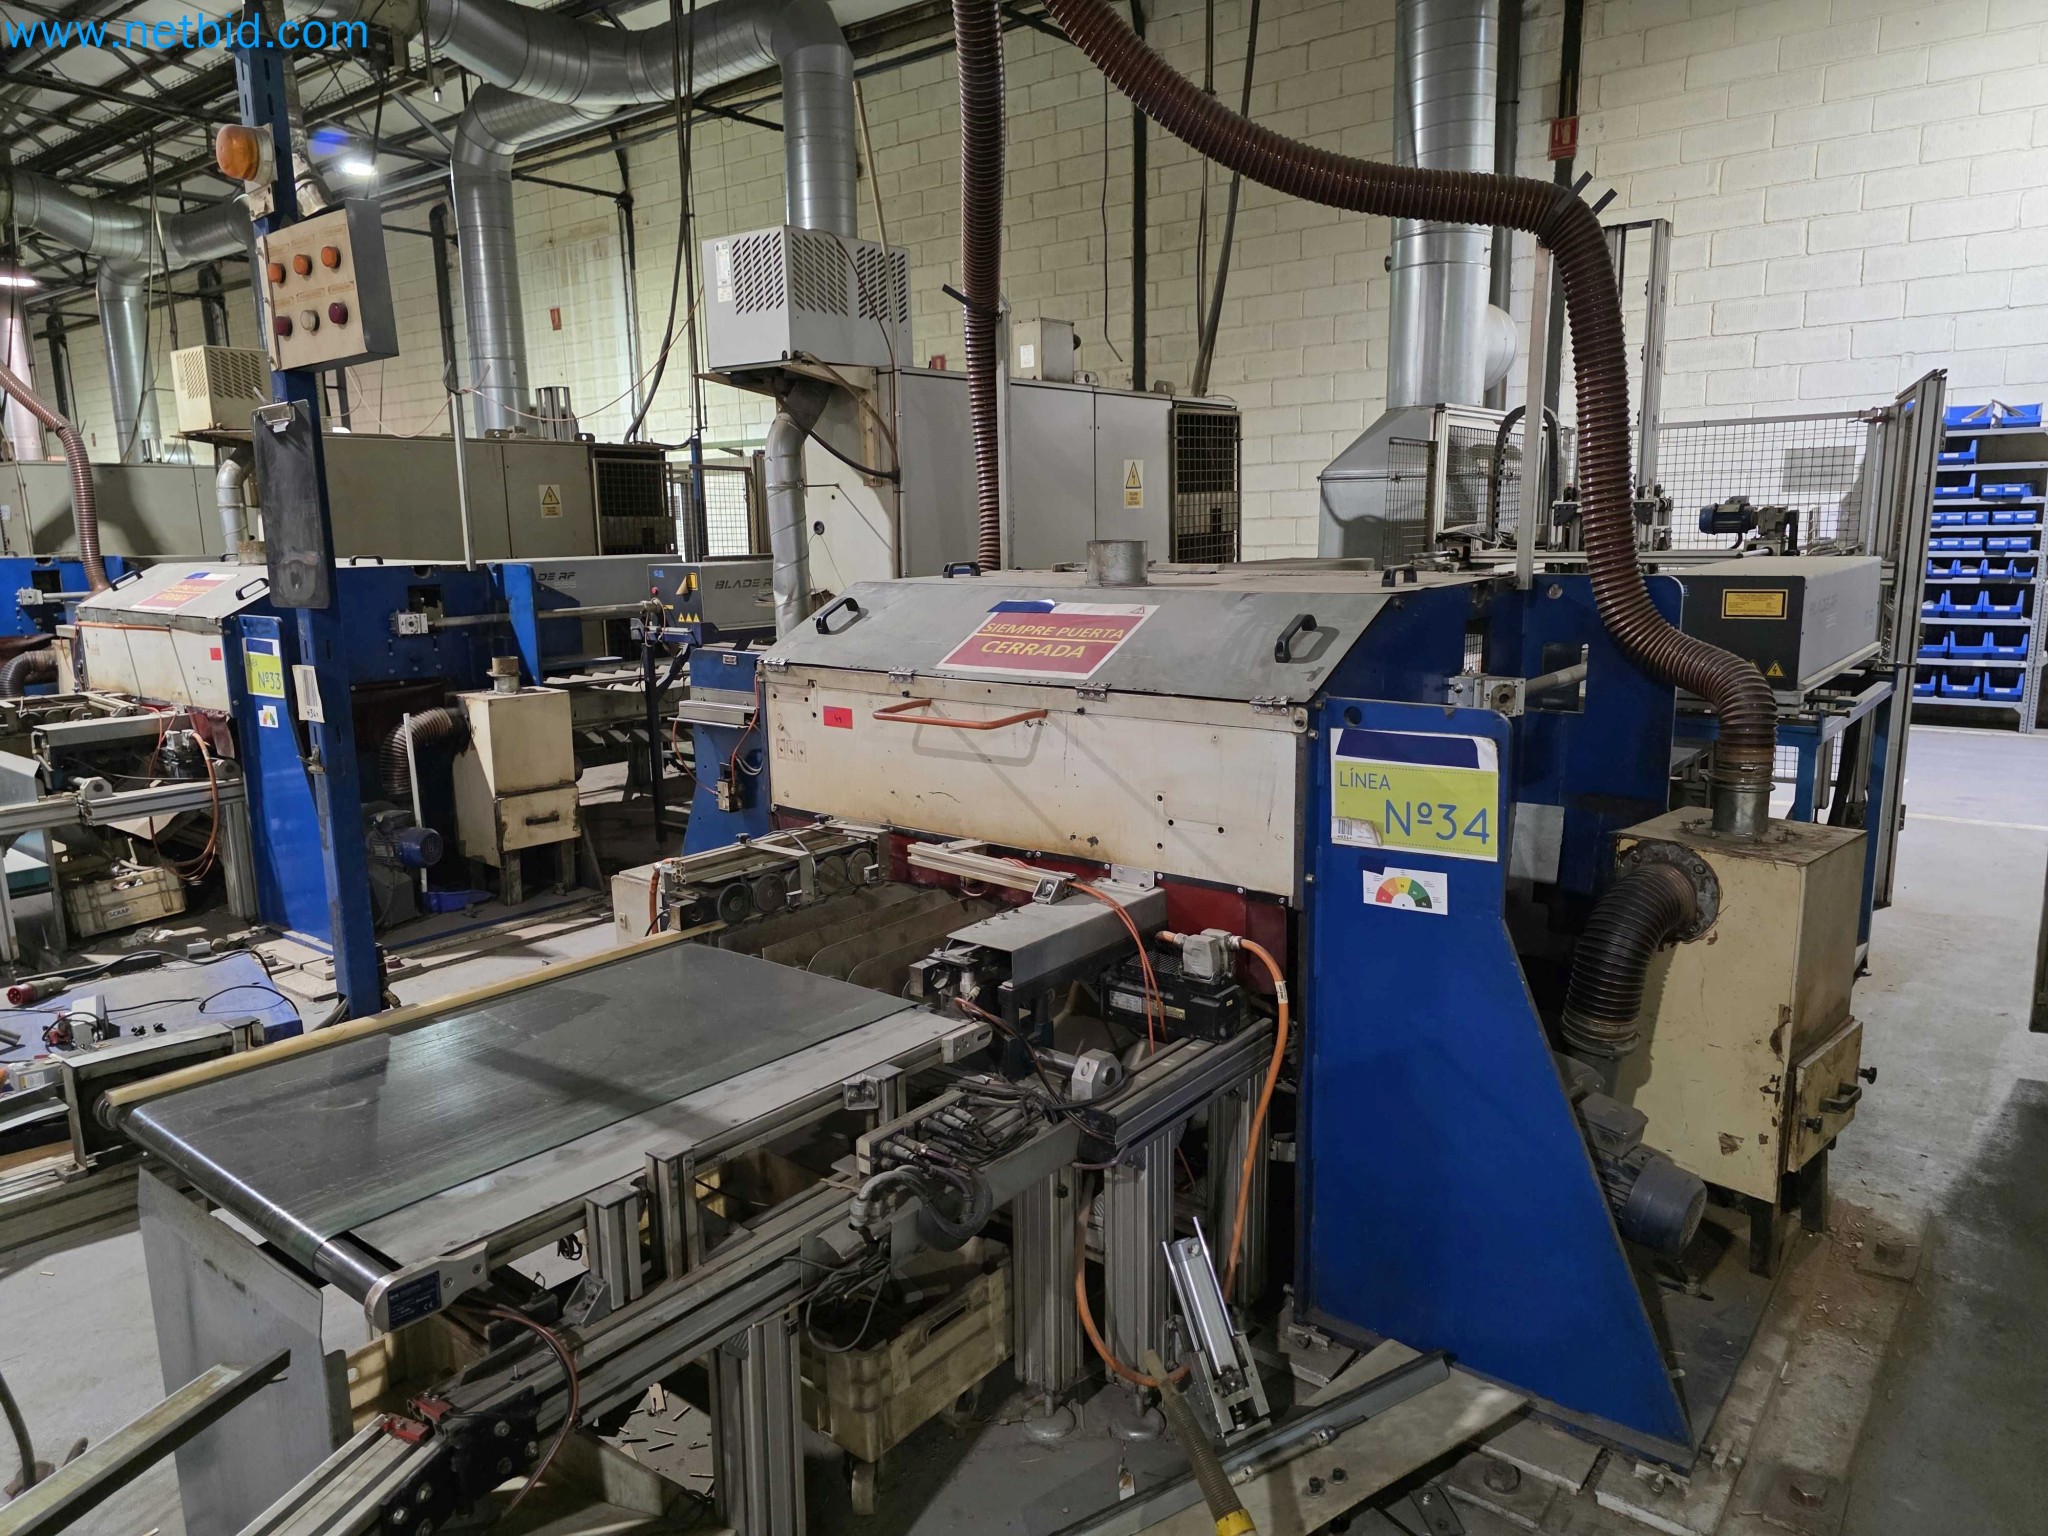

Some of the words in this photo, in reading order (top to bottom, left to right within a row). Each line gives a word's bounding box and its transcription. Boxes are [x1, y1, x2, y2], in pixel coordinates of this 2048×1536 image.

[715, 578, 760, 590] BLADE
[982, 622, 1056, 637] SIEMPRE
[1055, 626, 1125, 640] PUERTA
[981, 640, 1086, 659] CERRADA
[1340, 767, 1391, 791] LÍNEA
[1385, 799, 1490, 845] Nº34
[109, 908, 130, 917] SCRAP
